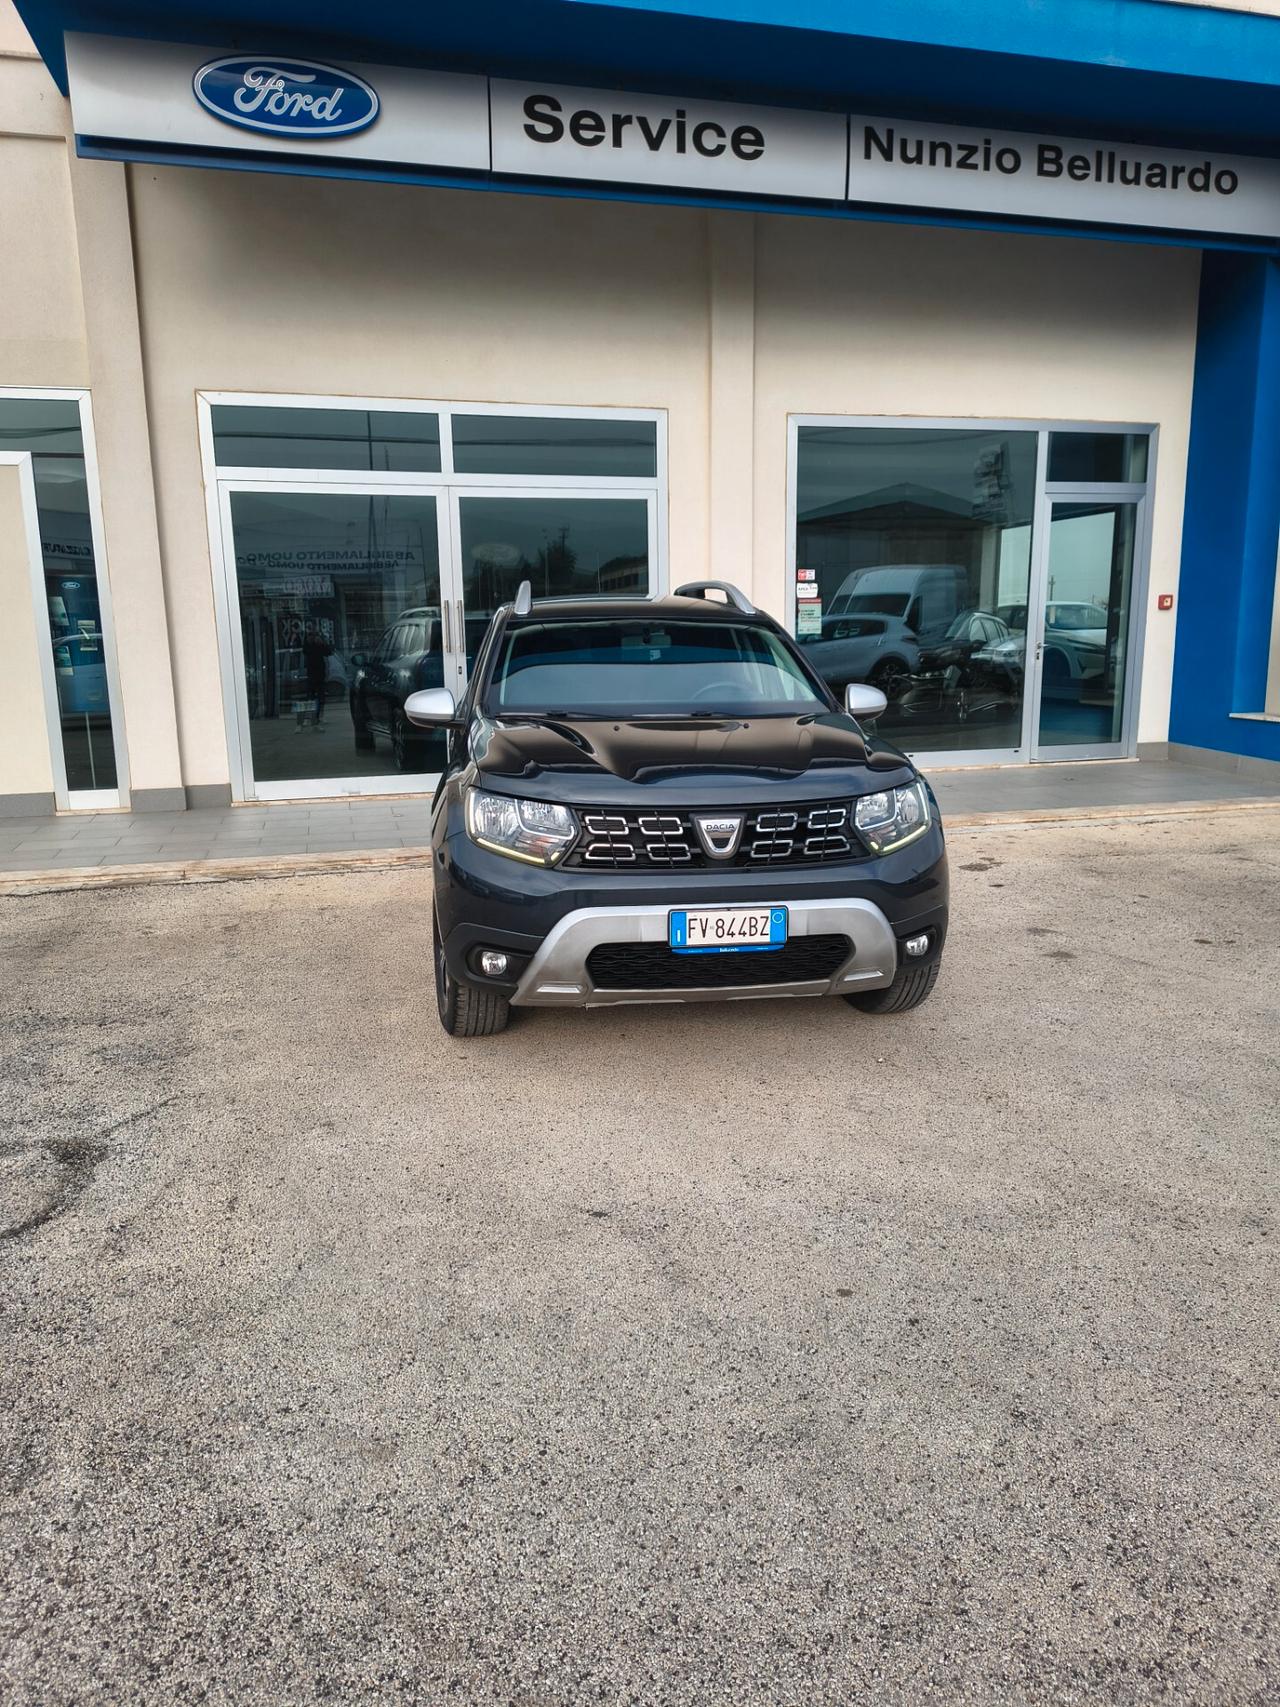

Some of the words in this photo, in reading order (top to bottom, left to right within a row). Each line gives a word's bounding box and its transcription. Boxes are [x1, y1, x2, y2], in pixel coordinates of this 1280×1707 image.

[233, 66, 344, 121] Ford
[523, 94, 765, 161] Service
[863, 126, 1021, 174] Nunzio
[1036, 143, 1239, 195] Belluardo
[688, 917, 709, 939] FV
[715, 916, 769, 938] 844BZ
